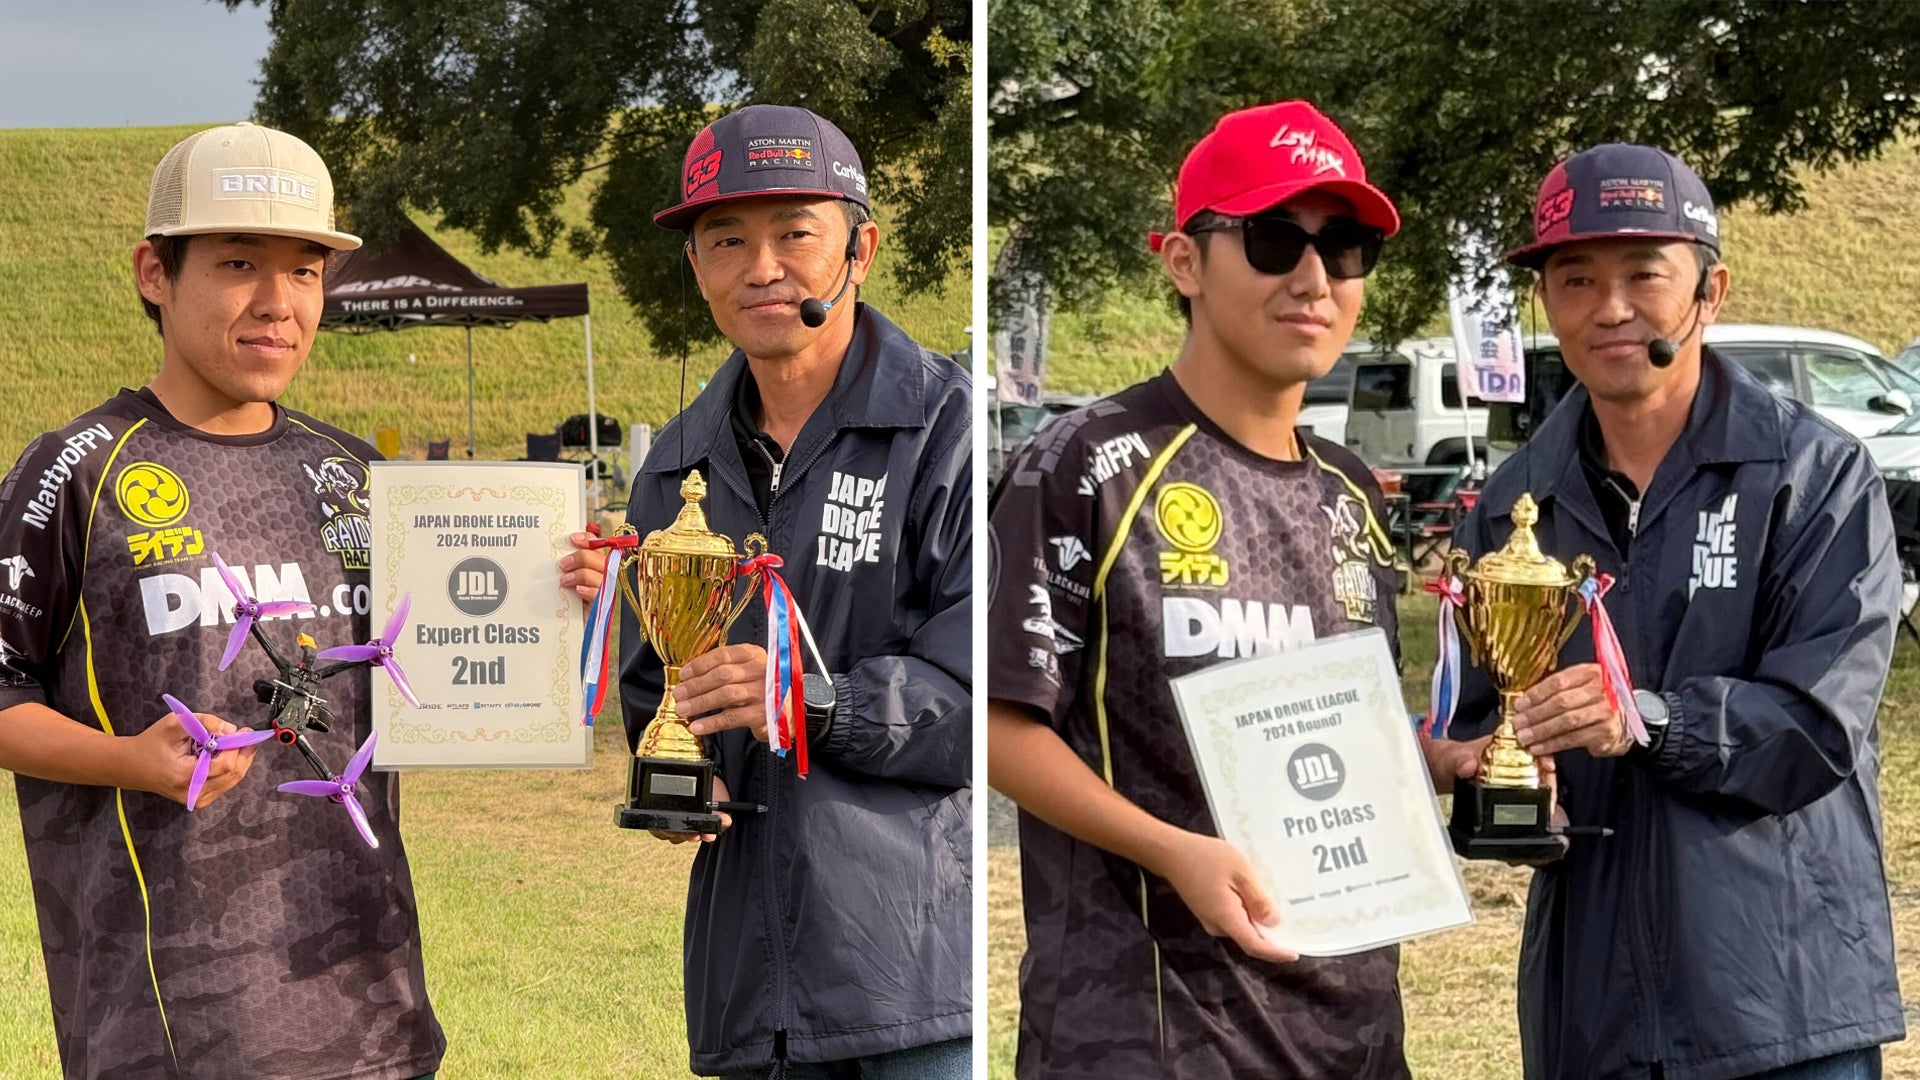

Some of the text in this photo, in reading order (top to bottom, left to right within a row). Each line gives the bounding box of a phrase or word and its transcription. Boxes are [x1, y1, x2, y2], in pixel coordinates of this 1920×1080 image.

[748, 138, 811, 147] ASTON MARTIN
[687, 150, 722, 196] 33
[749, 159, 812, 167] RACING
[220, 174, 316, 201] BRIDE
[341, 300, 390, 312] THERE
[394, 299, 408, 309] IS
[412, 298, 422, 308] A
[414, 515, 540, 529] JAPAN DRONE LEAGUE
[127, 526, 205, 566] ライデン
[436, 533, 518, 547] 2024 Round7
[456, 571, 499, 596] JDL
[1159, 551, 1230, 587] ライデン
[416, 623, 540, 646] Expert Class
[1162, 597, 1316, 658] DMM
[451, 656, 506, 685] 2nd
[1234, 689, 1360, 729] JAPAN DRONE LEAGUE
[1263, 712, 1343, 741] 2024 Round7
[1294, 753, 1339, 785] JDL
[1283, 804, 1376, 838] Pro Class
[1312, 836, 1368, 874] 2nd
